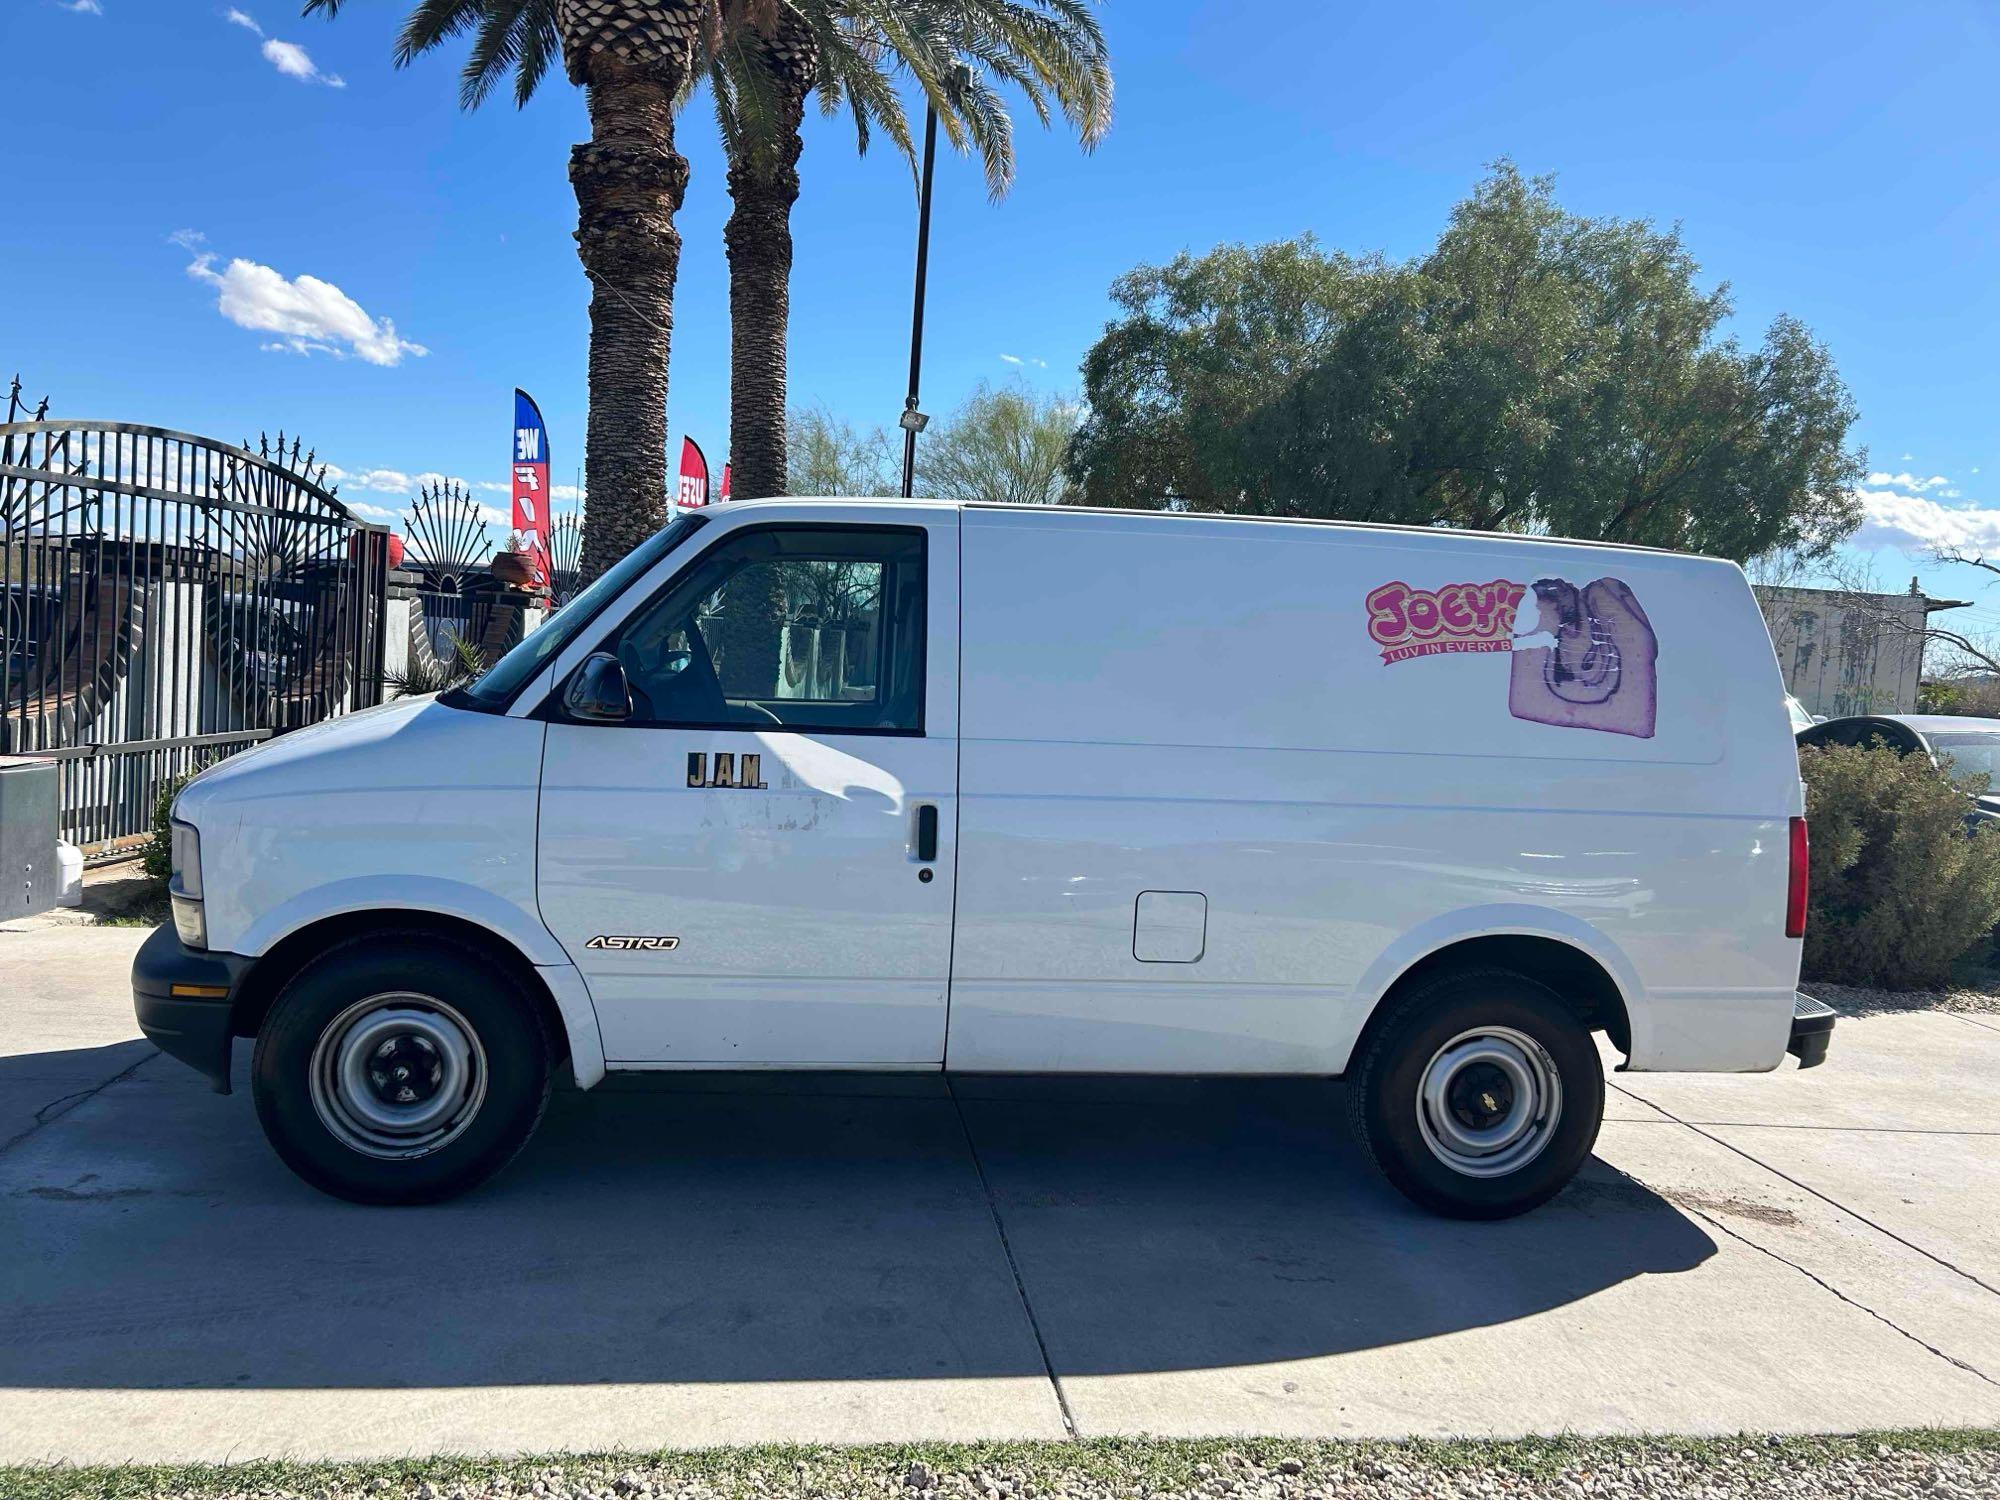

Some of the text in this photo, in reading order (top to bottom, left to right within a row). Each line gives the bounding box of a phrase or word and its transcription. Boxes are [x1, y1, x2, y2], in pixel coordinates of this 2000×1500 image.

[1389, 645, 1419, 662] LUV
[1425, 643, 1441, 655] IN
[1445, 641, 1496, 653] EVERY
[687, 752, 768, 789] J.A.M.
[585, 935, 680, 950] ASTRO
